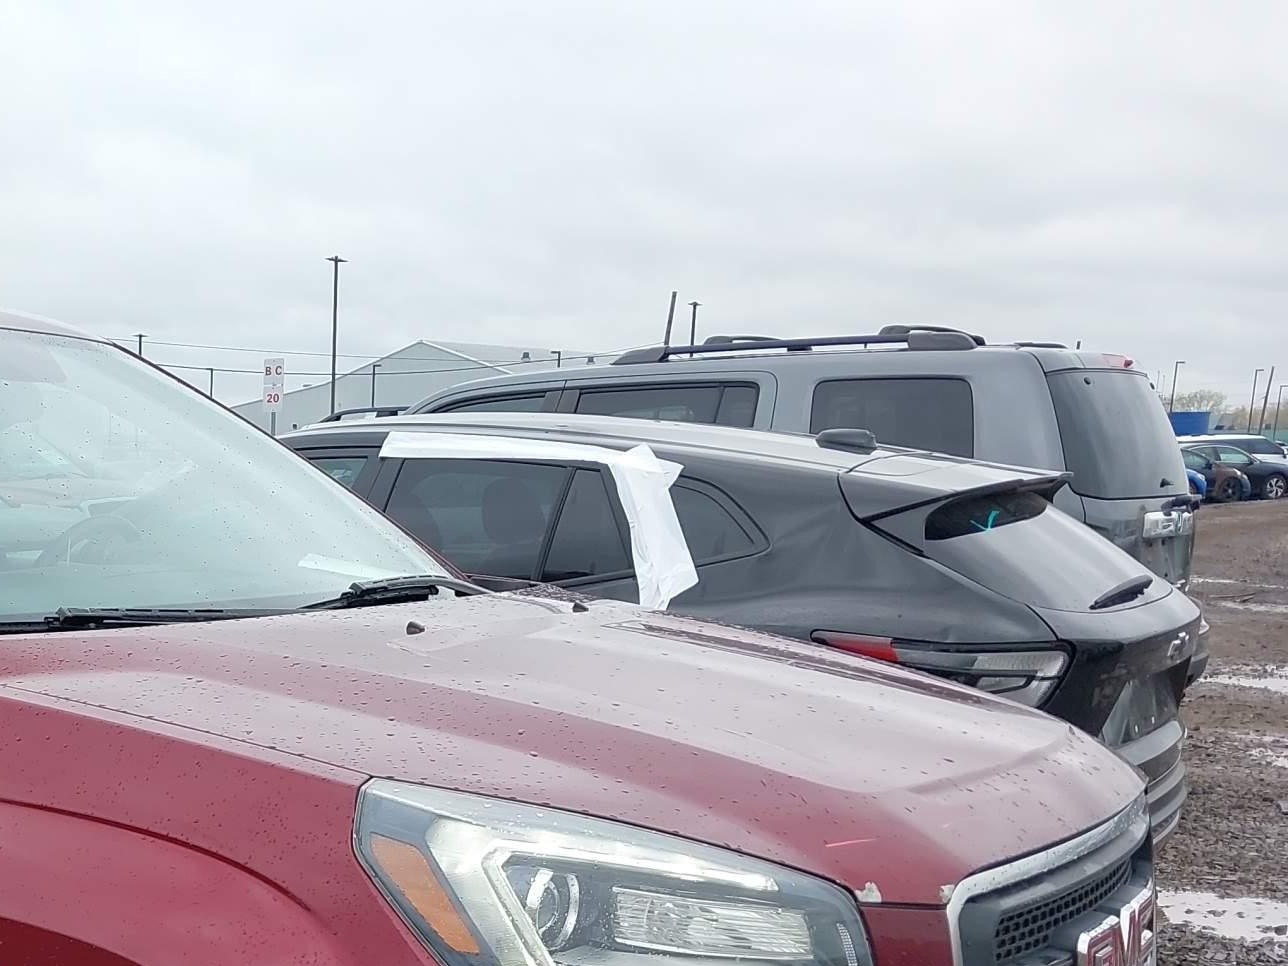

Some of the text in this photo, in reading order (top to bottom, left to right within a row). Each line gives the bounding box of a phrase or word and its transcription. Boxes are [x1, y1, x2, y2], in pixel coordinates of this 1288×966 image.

[265, 365, 283, 376] B C
[266, 393, 280, 404] 20
